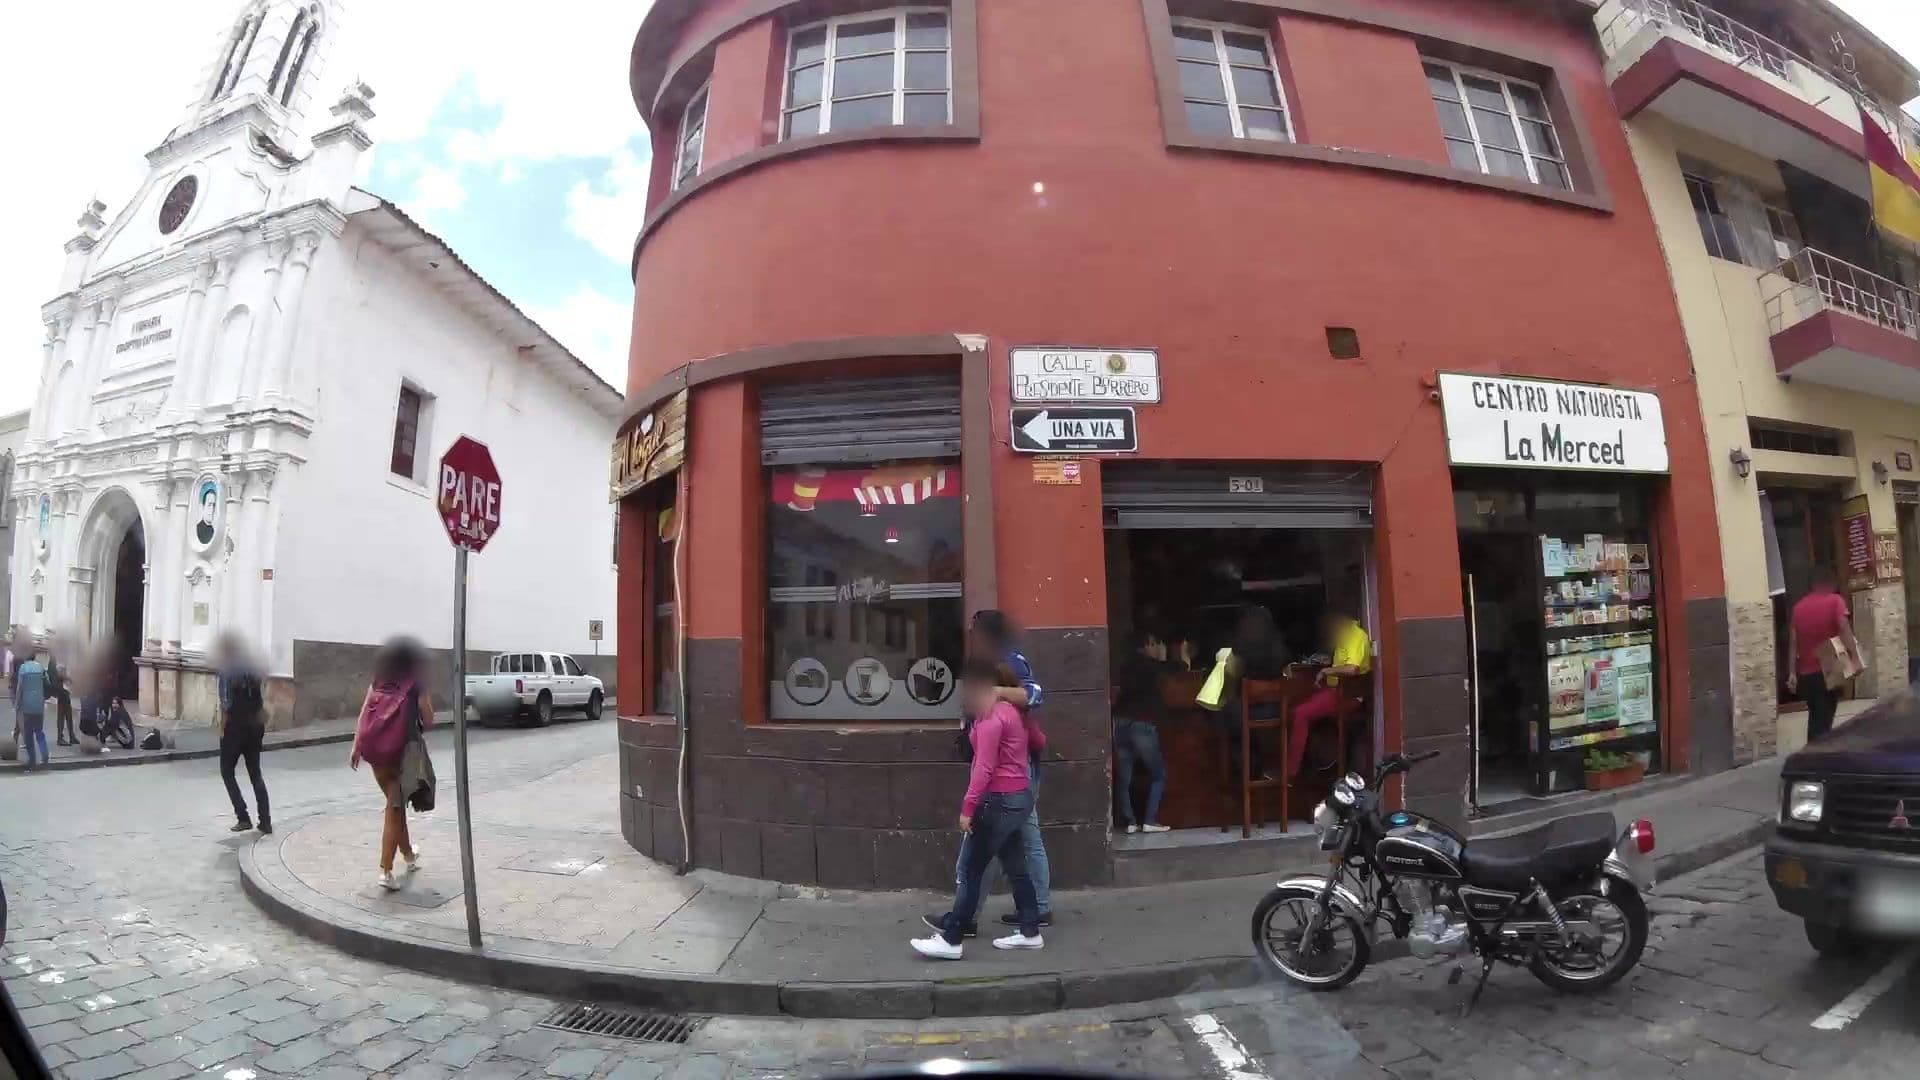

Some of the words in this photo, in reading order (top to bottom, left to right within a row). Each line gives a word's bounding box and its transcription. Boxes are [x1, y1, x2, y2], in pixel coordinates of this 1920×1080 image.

[1042, 353, 1097, 373] CALLE
[1472, 381, 1549, 413] CENTRO
[1555, 388, 1643, 421] NATURISTA
[1052, 421, 1084, 438] UNA
[1089, 421, 1116, 439] VIA
[1503, 419, 1536, 461] La
[1541, 422, 1625, 465] Merced
[441, 463, 500, 522] PARE
